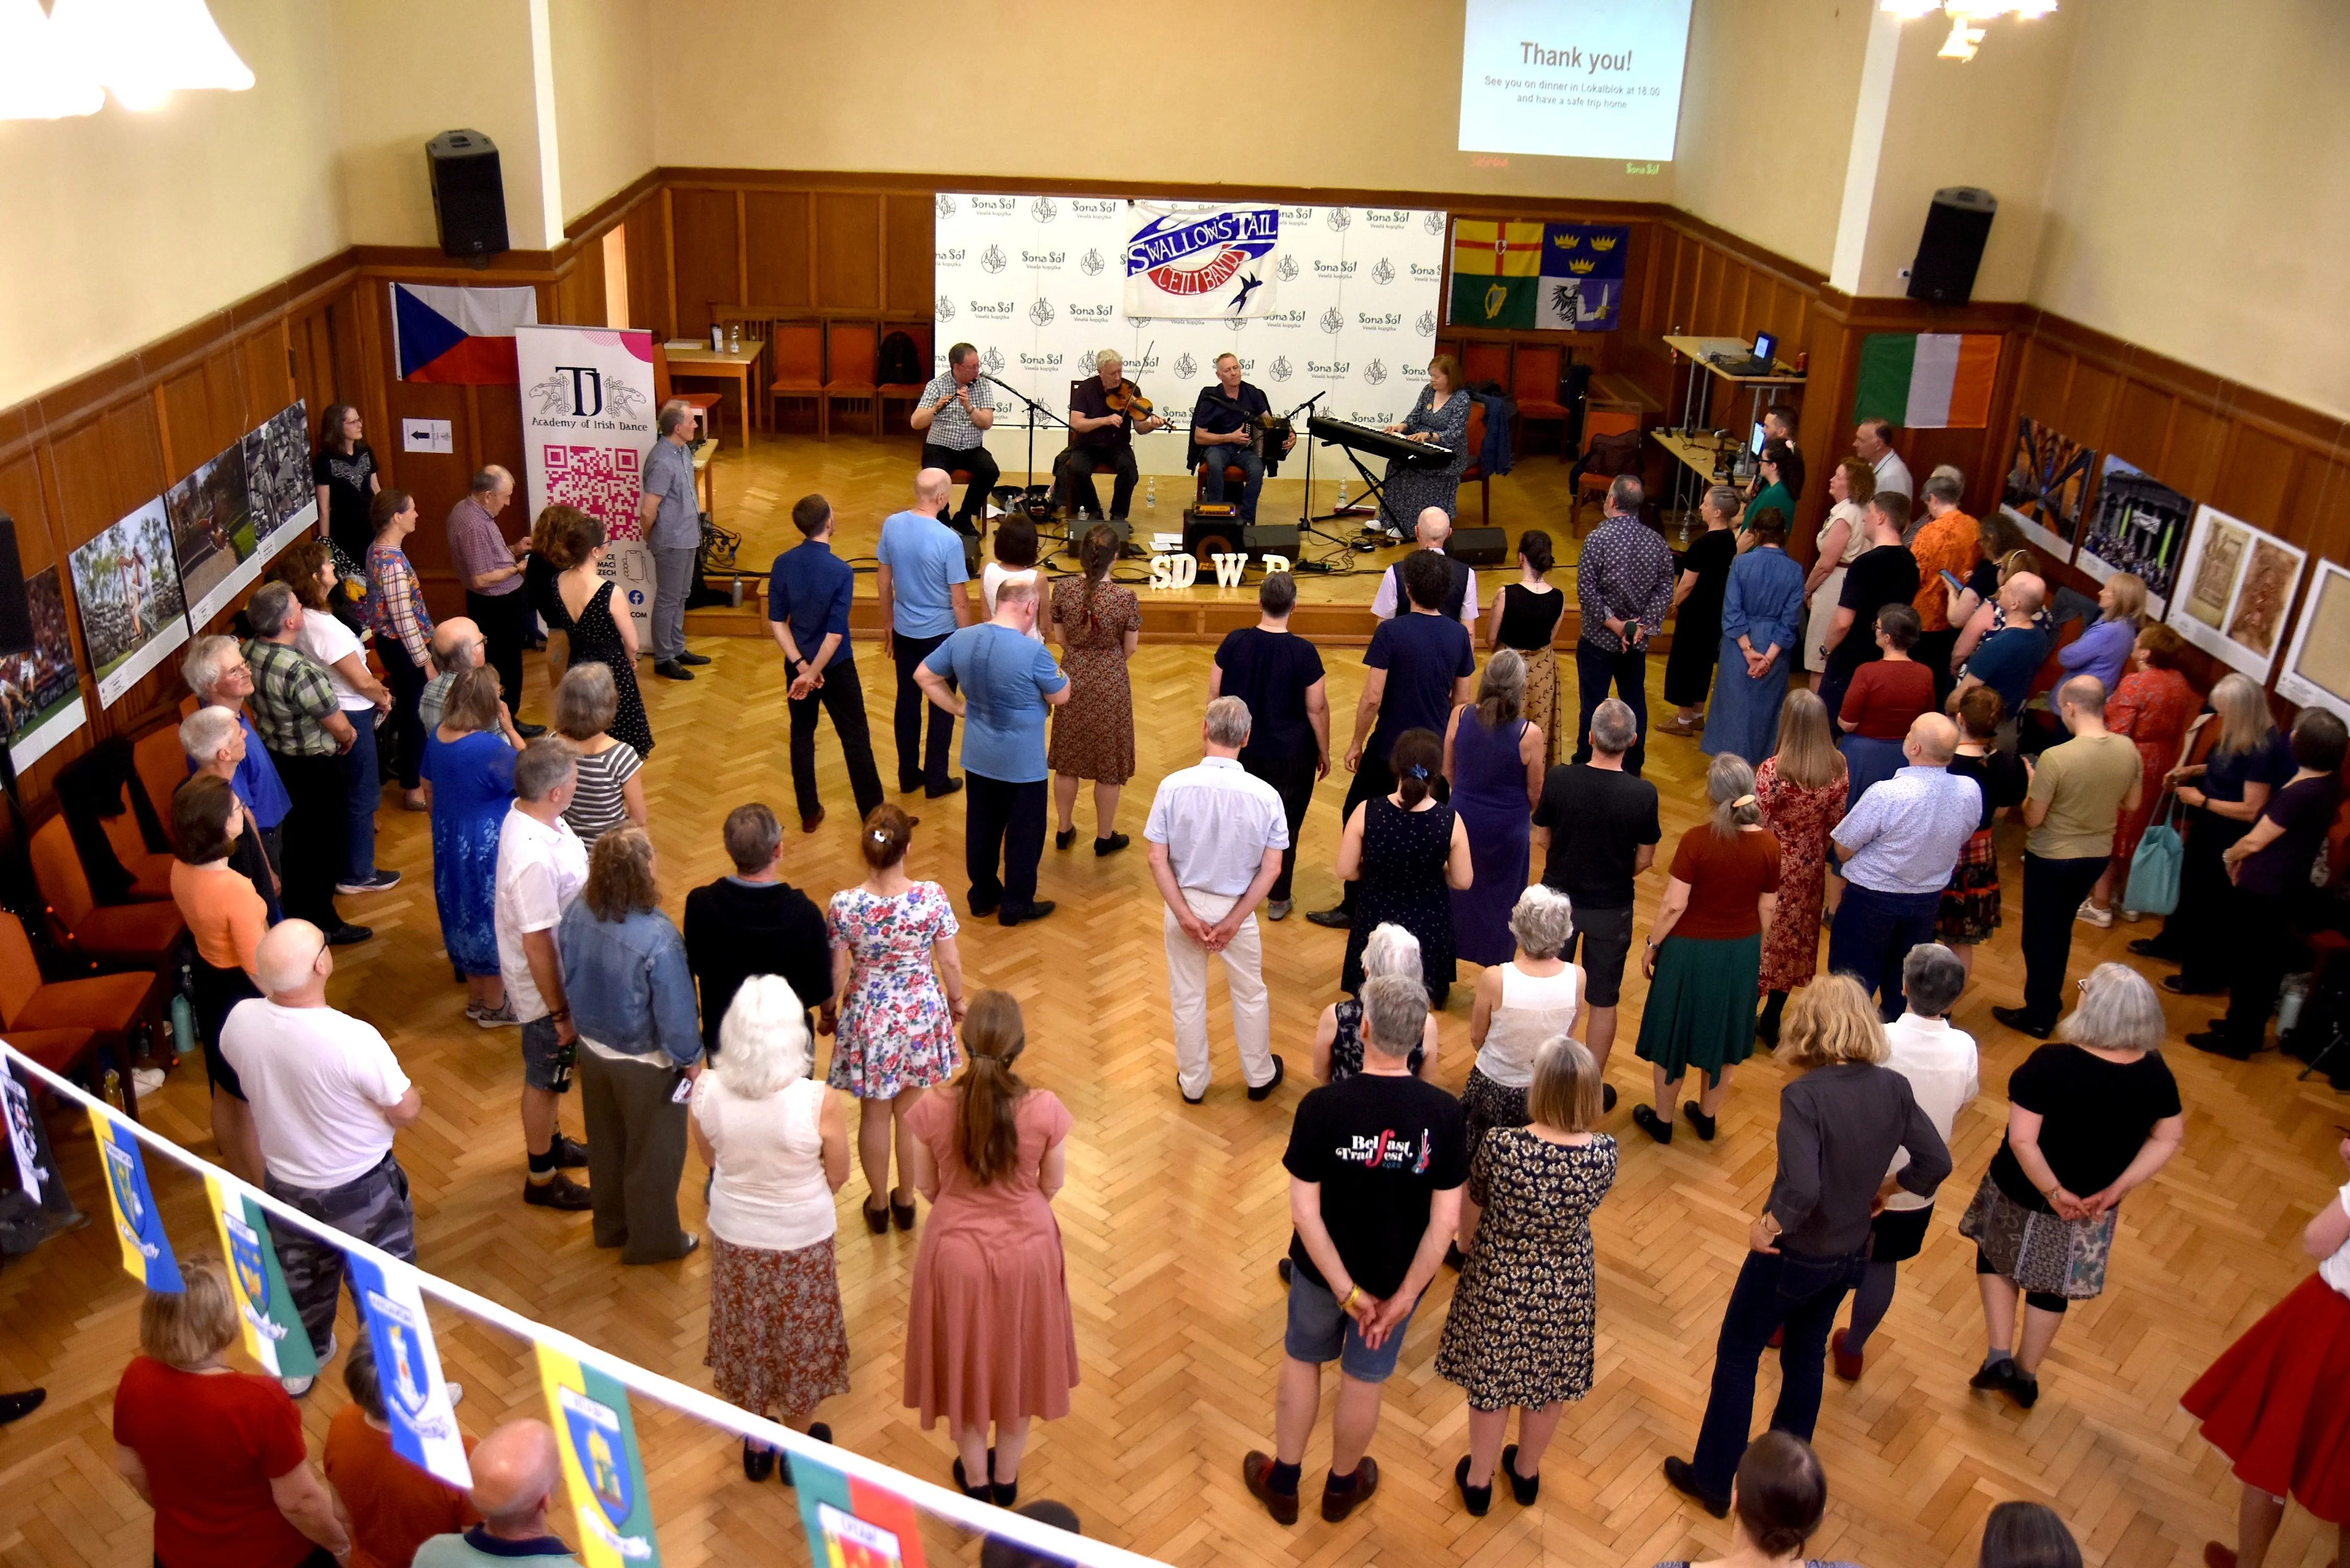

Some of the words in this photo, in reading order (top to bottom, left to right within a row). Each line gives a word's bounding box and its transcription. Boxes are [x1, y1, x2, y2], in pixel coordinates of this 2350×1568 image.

[1520, 41, 1583, 68] Thank
[1588, 50, 1632, 74] you!
[1484, 75, 1502, 86] See
[1505, 78, 1522, 89] you
[1525, 80, 1536, 89] on
[1539, 80, 1568, 91] dinner
[1570, 83, 1578, 91] in
[1581, 82, 1623, 95] Lokalblok
[1627, 87, 1634, 95] at
[1517, 94, 1533, 103] and
[1536, 95, 1557, 104] have
[1567, 96, 1584, 107] safe
[1587, 98, 1601, 109] trip
[1604, 99, 1627, 108] home
[972, 198, 997, 209] Sona
[999, 198, 1016, 210] Sól
[1073, 201, 1098, 212] Sona
[1100, 201, 1116, 213] Sól
[1296, 207, 1312, 219] Sól
[1366, 211, 1391, 222] Sona
[1393, 212, 1410, 223] Sól
[1232, 213, 1276, 240] TAIL
[949, 249, 965, 260] Sól
[1022, 251, 1047, 262] Sona
[1049, 251, 1066, 263] Sól
[1204, 251, 1239, 291] BAND
[1314, 260, 1339, 271] Sona
[1340, 261, 1357, 272] Sól
[1410, 264, 1435, 275] Sona
[971, 301, 995, 313] Sona
[997, 302, 1014, 314] Sól
[1070, 304, 1095, 315] Sona
[1097, 305, 1113, 316] Sól
[1289, 310, 1306, 321] Sól
[1359, 313, 1383, 324] Sona
[1385, 314, 1401, 325] Sól
[1020, 353, 1045, 364] Sona
[1047, 353, 1063, 365] Sól
[1307, 361, 1331, 373] Sona
[1333, 362, 1350, 373] Sól
[1402, 364, 1426, 375] Sona
[996, 402, 1012, 413] Sól
[1163, 406, 1187, 418] Sona
[1352, 411, 1376, 423] Sona
[1377, 412, 1393, 423] Sól
[532, 417, 576, 429] Academy
[581, 420, 590, 428] of
[594, 421, 615, 430] Irish
[620, 422, 648, 431] Dance
[1352, 1128, 1413, 1158] Belfast
